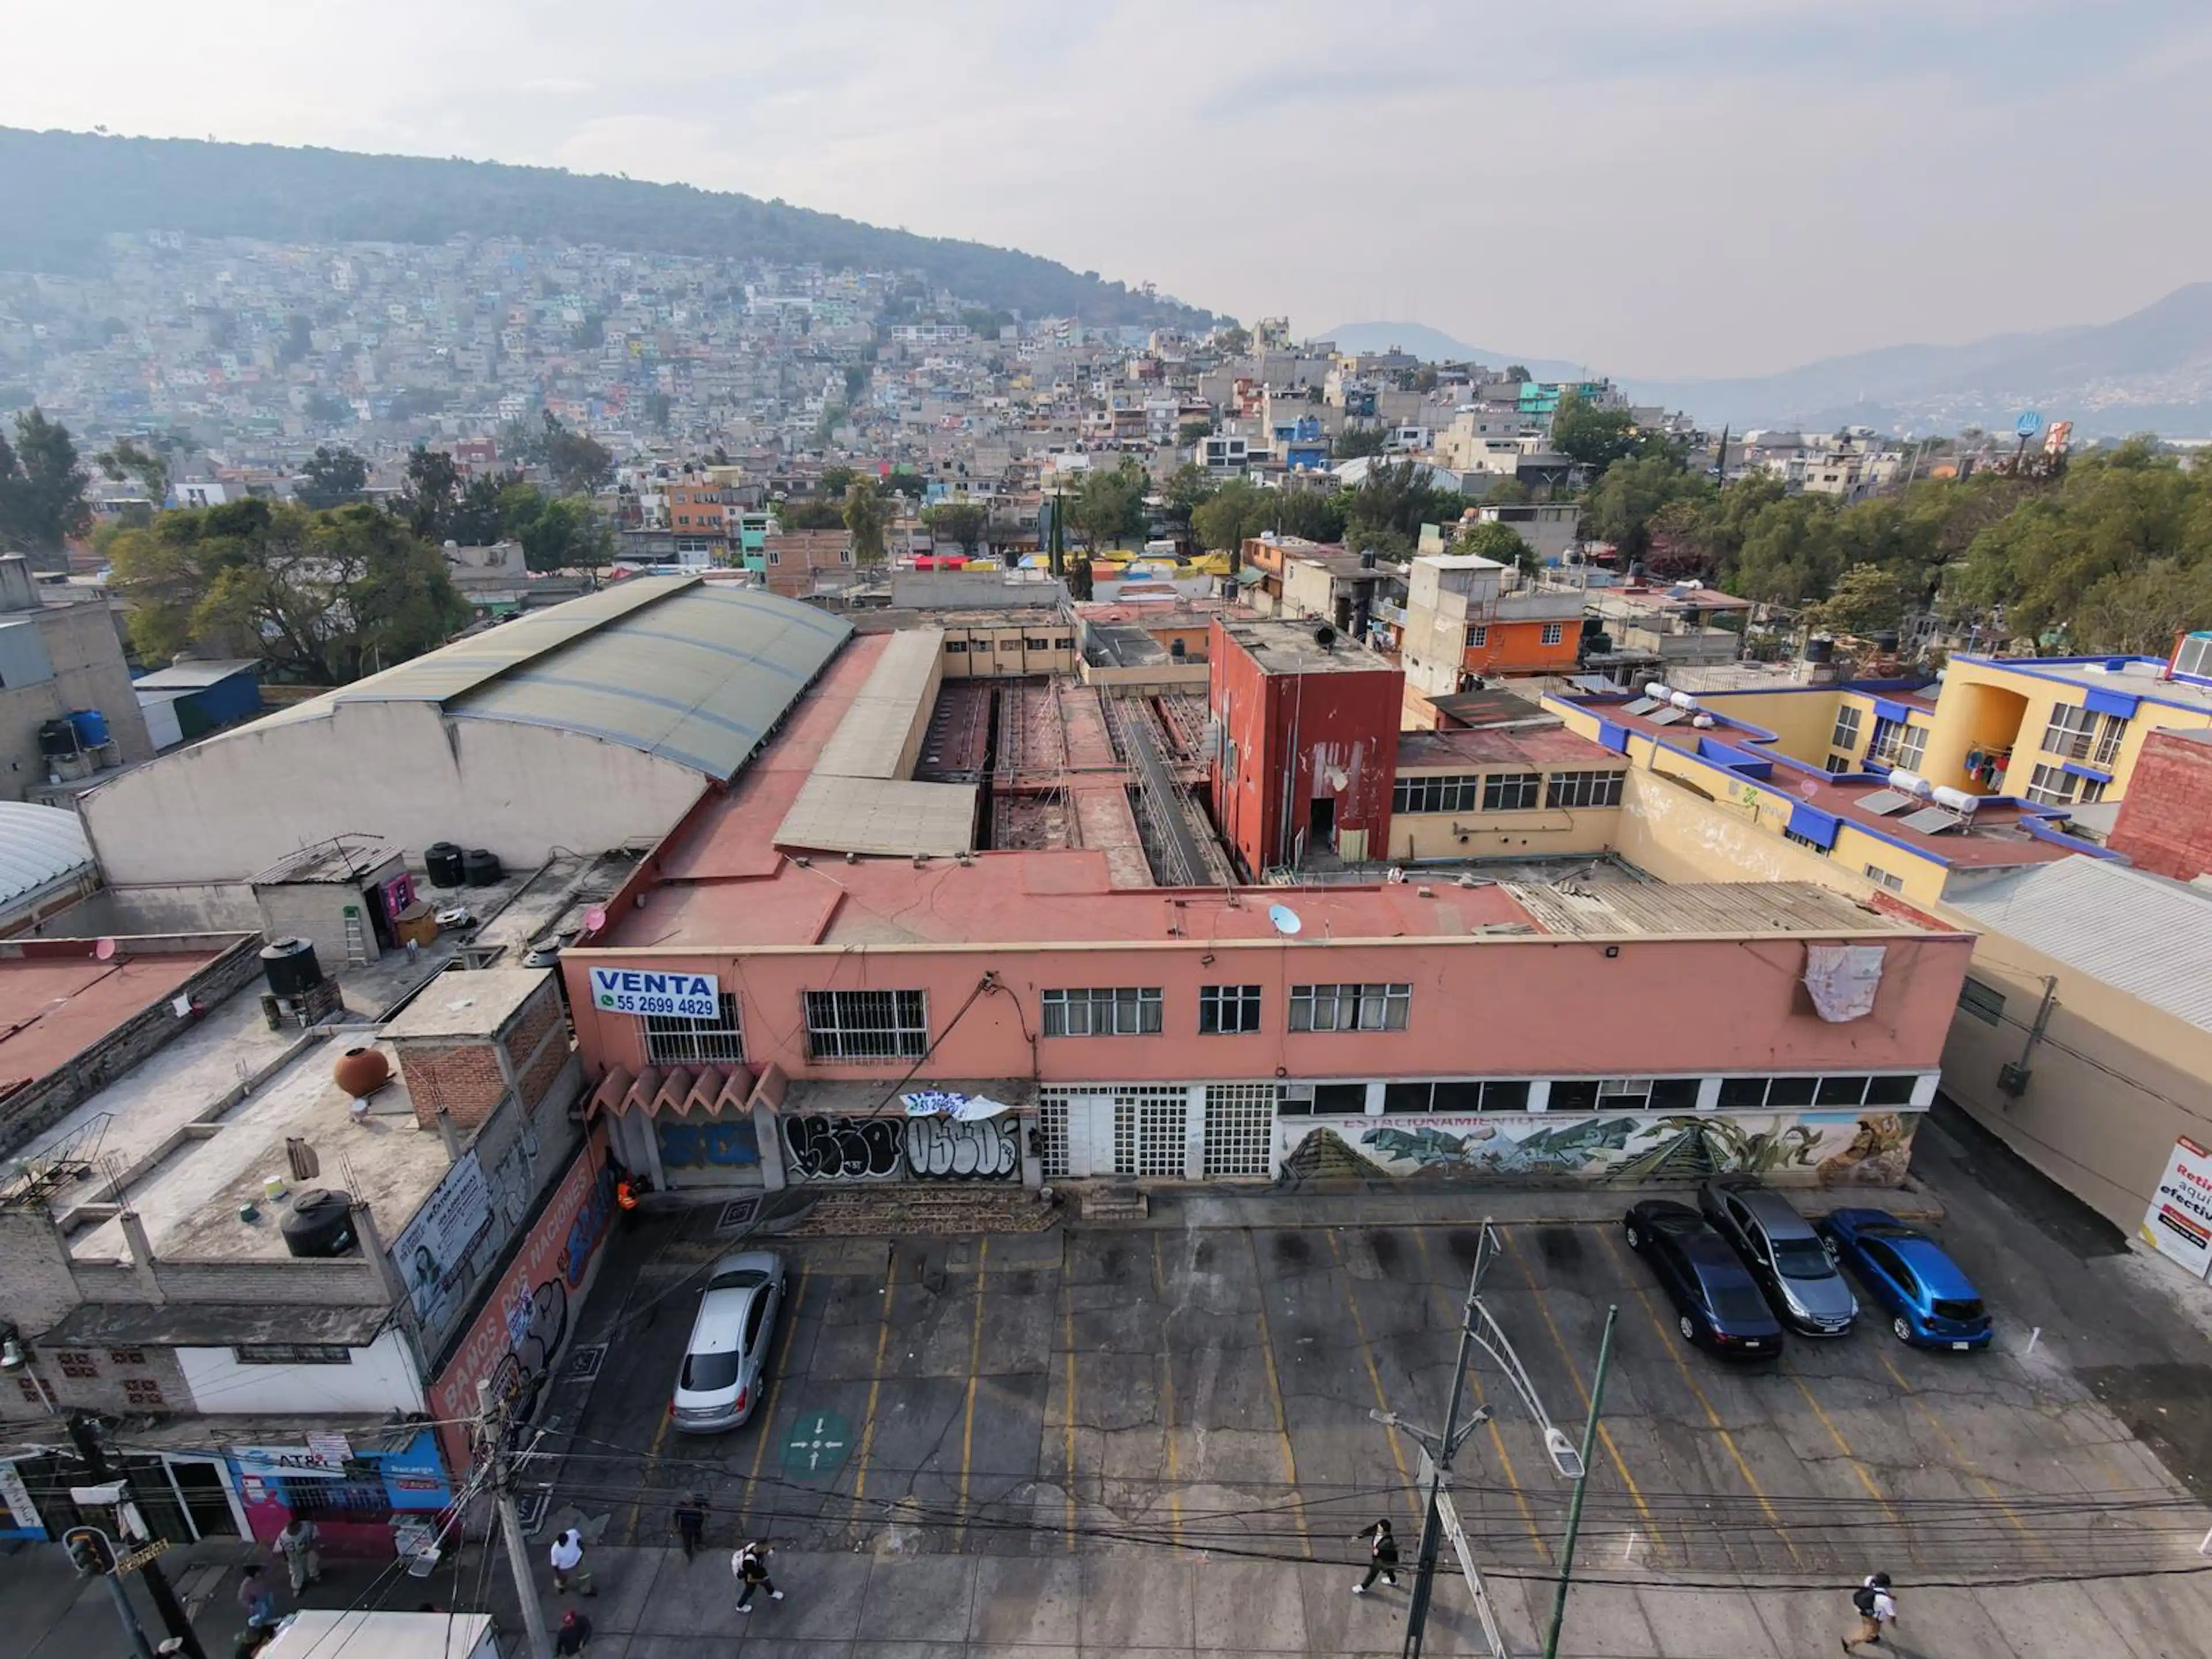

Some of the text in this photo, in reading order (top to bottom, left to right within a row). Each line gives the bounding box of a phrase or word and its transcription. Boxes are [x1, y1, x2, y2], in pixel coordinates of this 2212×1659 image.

[596, 971, 713, 996] VENTA
[617, 995, 713, 1015] 55 2699 4829
[1343, 1116, 1531, 1128] ESTACIONAMIENTO
[444, 1316, 498, 1413] BAÑOS
[529, 1167, 589, 1271] NACIONES
